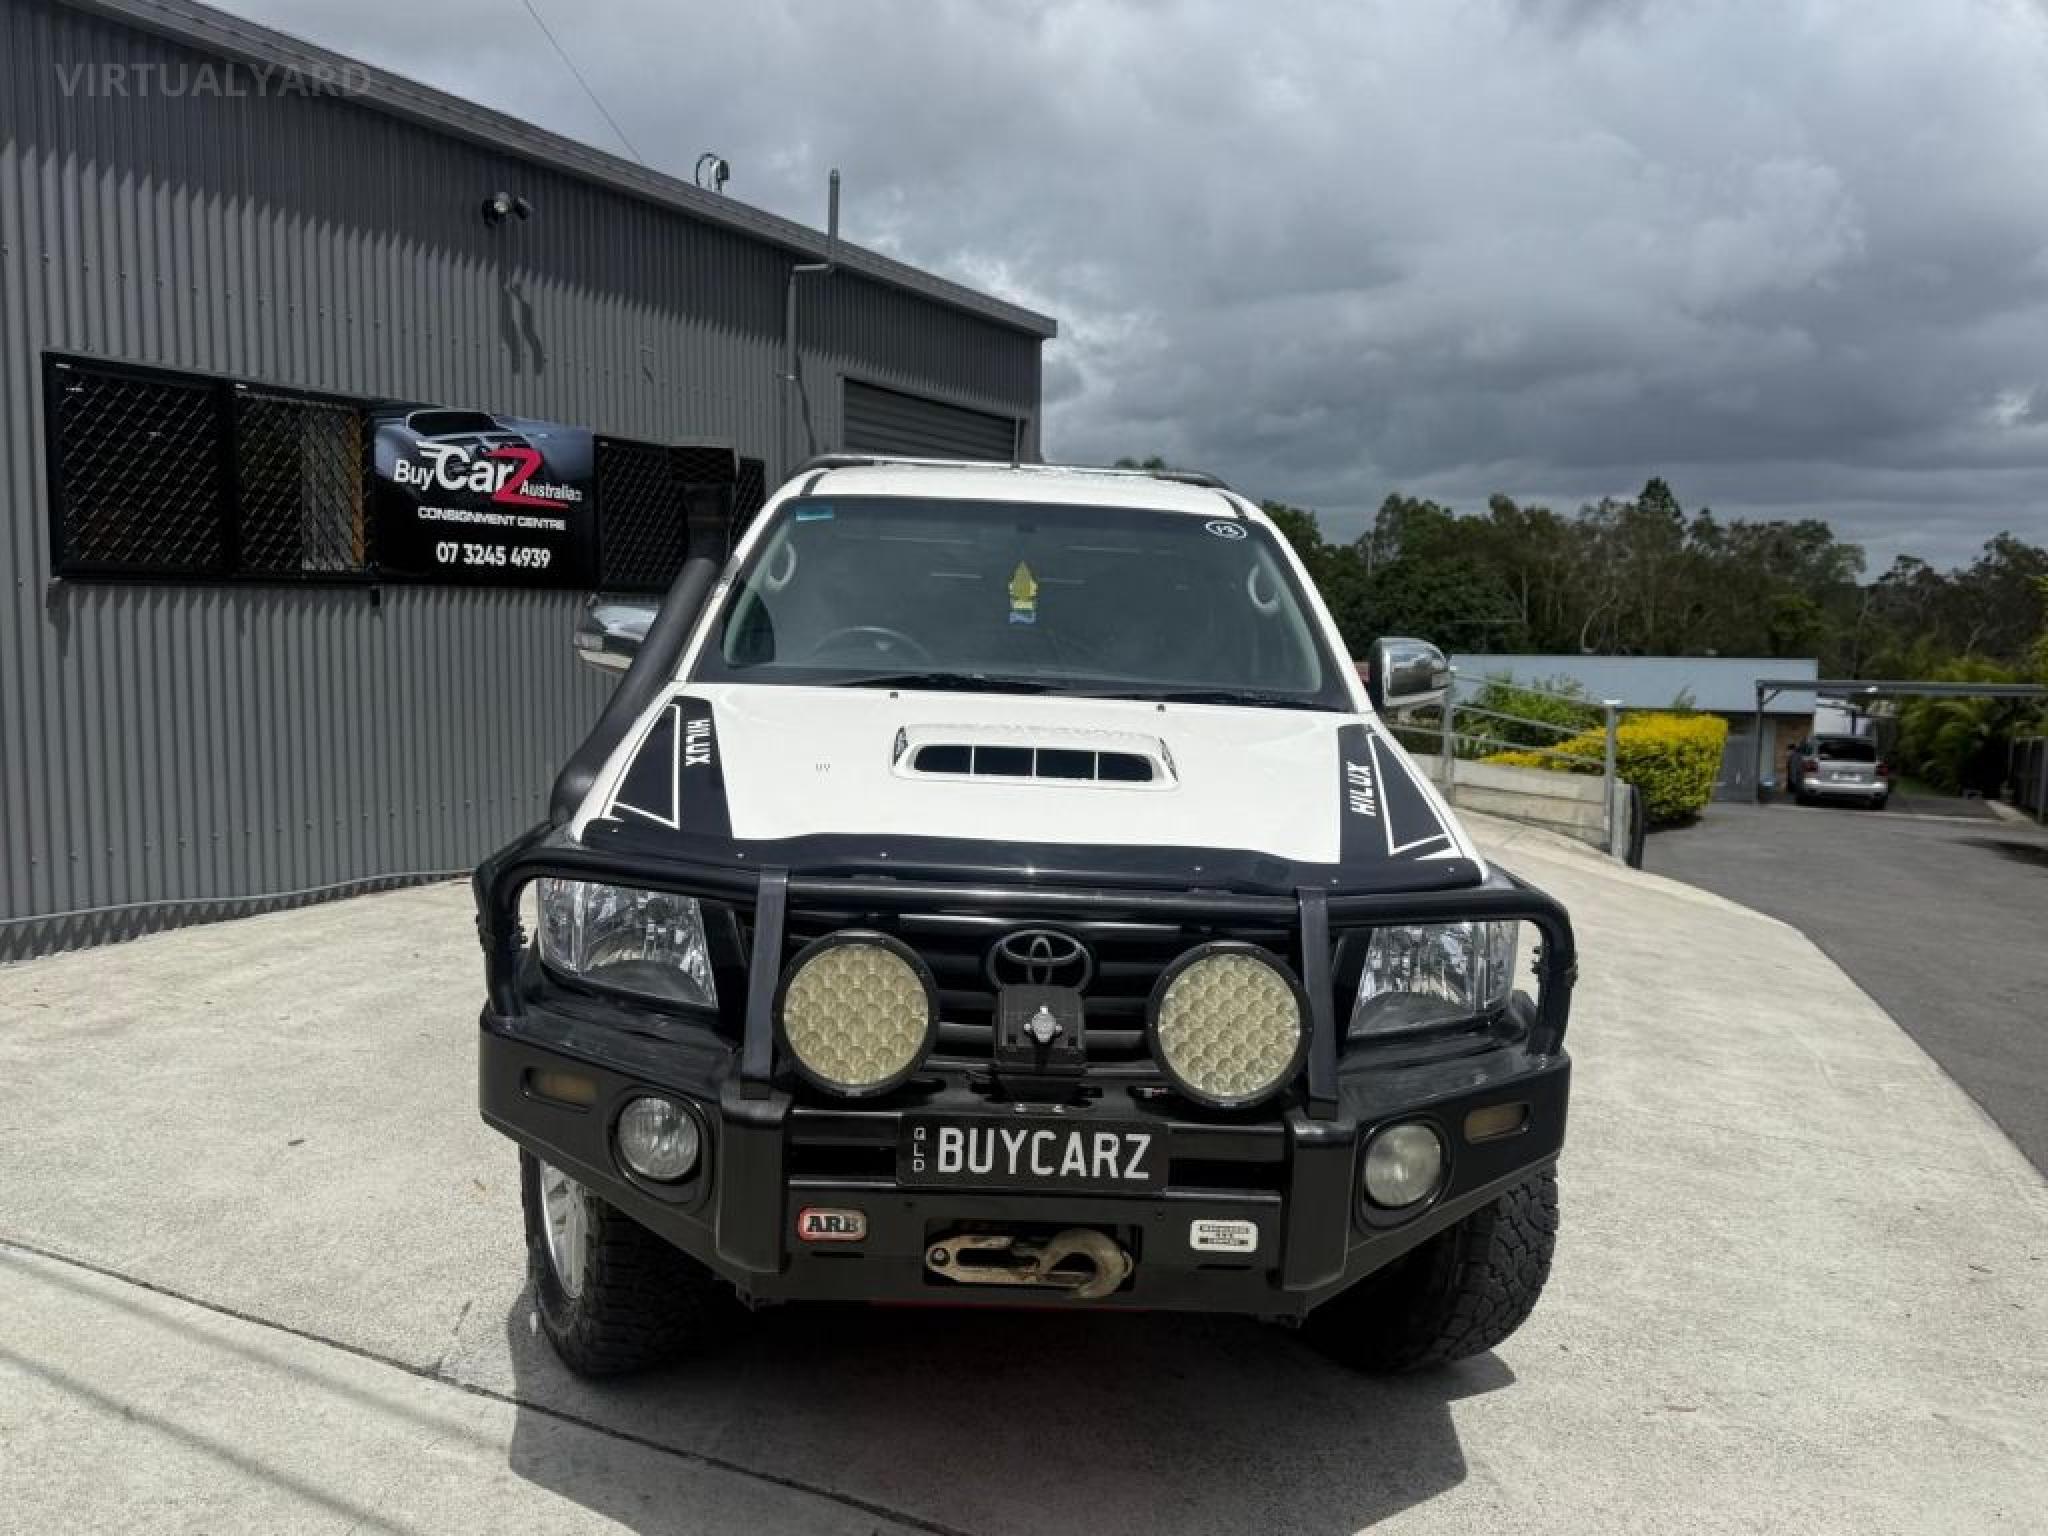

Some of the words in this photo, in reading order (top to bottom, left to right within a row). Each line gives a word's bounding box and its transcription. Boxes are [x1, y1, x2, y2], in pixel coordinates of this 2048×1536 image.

[417, 505, 516, 526] CONSIGNMENT
[436, 541, 459, 564] 07
[463, 543, 507, 567] 3245
[510, 546, 552, 569] 4939
[686, 719, 711, 767] HILUX
[1346, 761, 1377, 816] HILUX
[937, 1126, 1152, 1180] BUYCARZ
